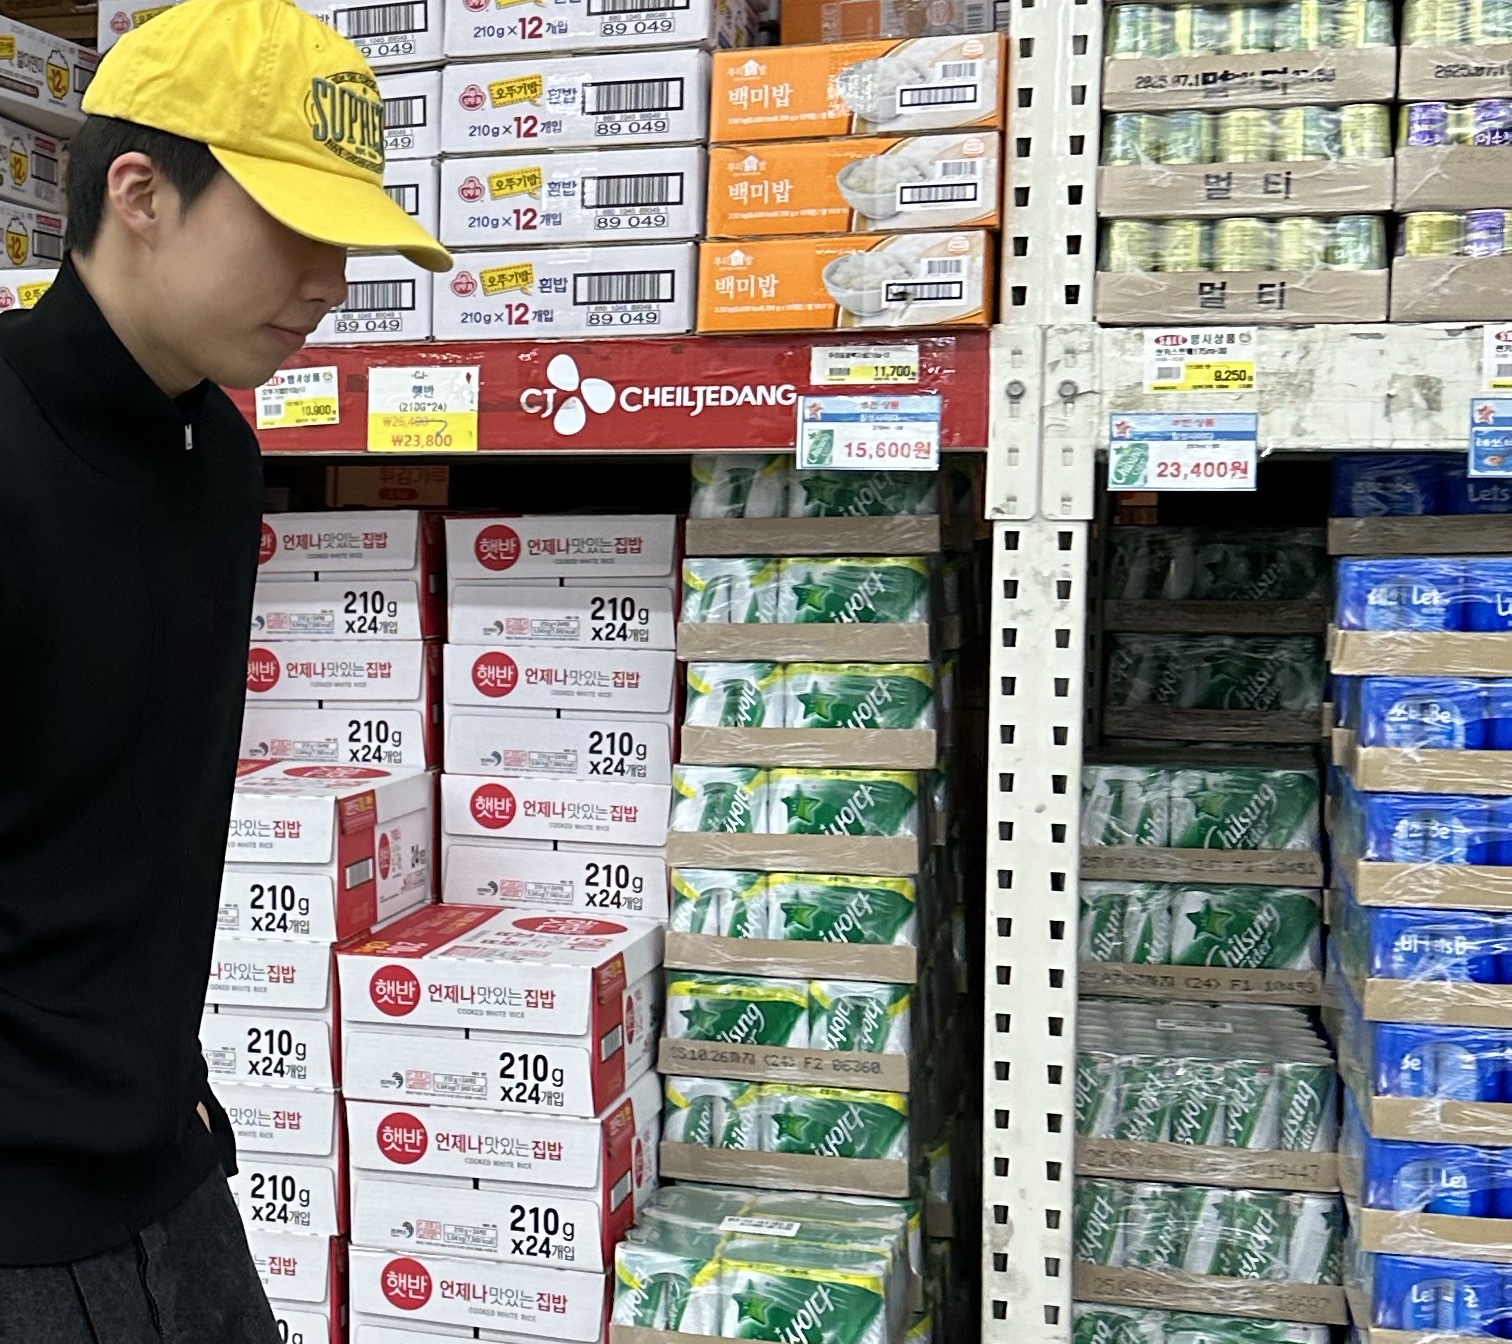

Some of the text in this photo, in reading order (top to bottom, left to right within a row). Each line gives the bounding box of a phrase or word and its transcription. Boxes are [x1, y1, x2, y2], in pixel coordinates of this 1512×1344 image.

[728, 83, 794, 110] 백미밥
[728, 178, 794, 206] 백미밥
[714, 273, 780, 300] 백미밥
[519, 383, 798, 419] CJ CHEILJEDANG
[845, 441, 931, 460] 15,600원
[1157, 461, 1248, 480] 23,400원
[477, 537, 516, 560] 햇반
[476, 662, 514, 687] 햇반
[382, 1124, 424, 1152] 햇반
